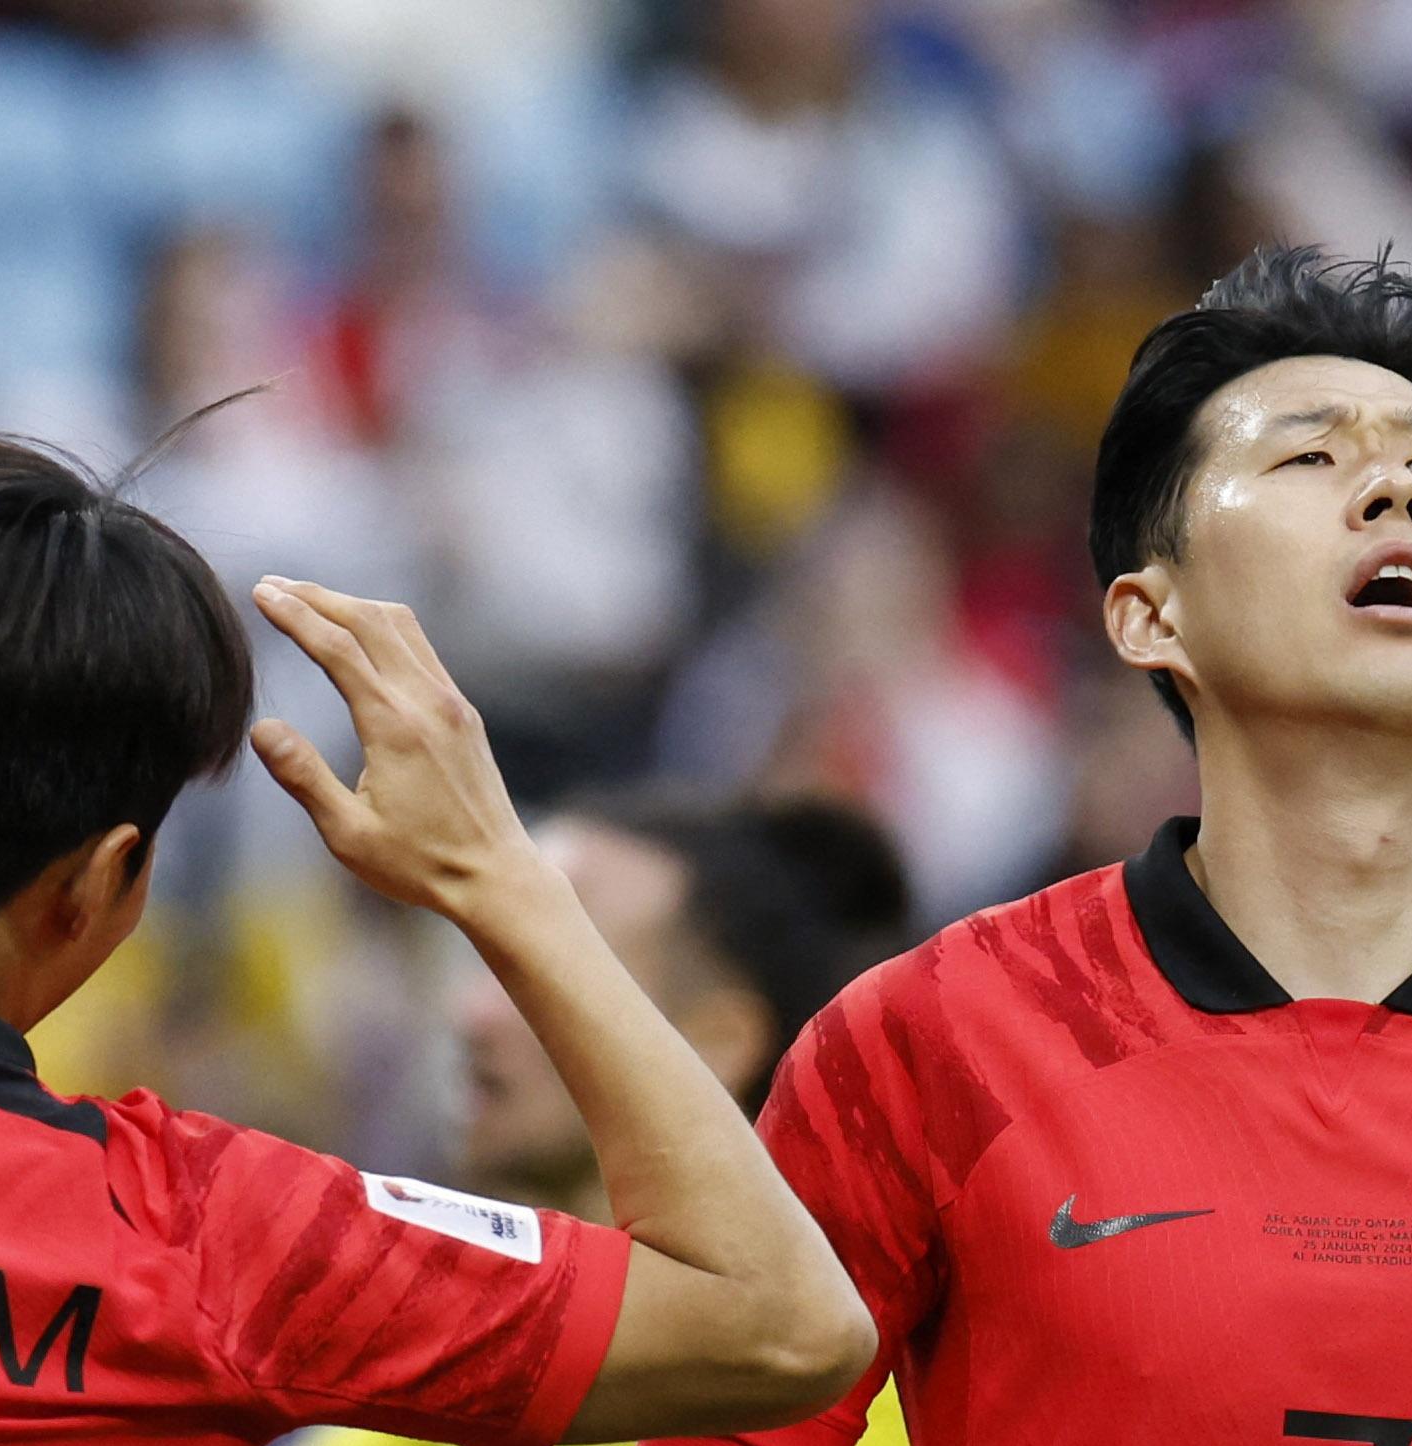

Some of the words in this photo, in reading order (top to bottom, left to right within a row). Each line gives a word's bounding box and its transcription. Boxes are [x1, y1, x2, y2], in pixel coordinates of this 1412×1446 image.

[1292, 1215, 1331, 1227] ASIAN
[1335, 1216, 1361, 1228] CUP
[1365, 1218, 1406, 1229] QATAR
[1262, 1225, 1303, 1237] KOREA
[1307, 1228, 1368, 1241] REPUBLIC
[1302, 1239, 1317, 1251] 25
[1321, 1240, 1377, 1253] JANUARY
[1383, 1243, 1412, 1254] 2024
[1312, 1253, 1362, 1265] JANOUB
